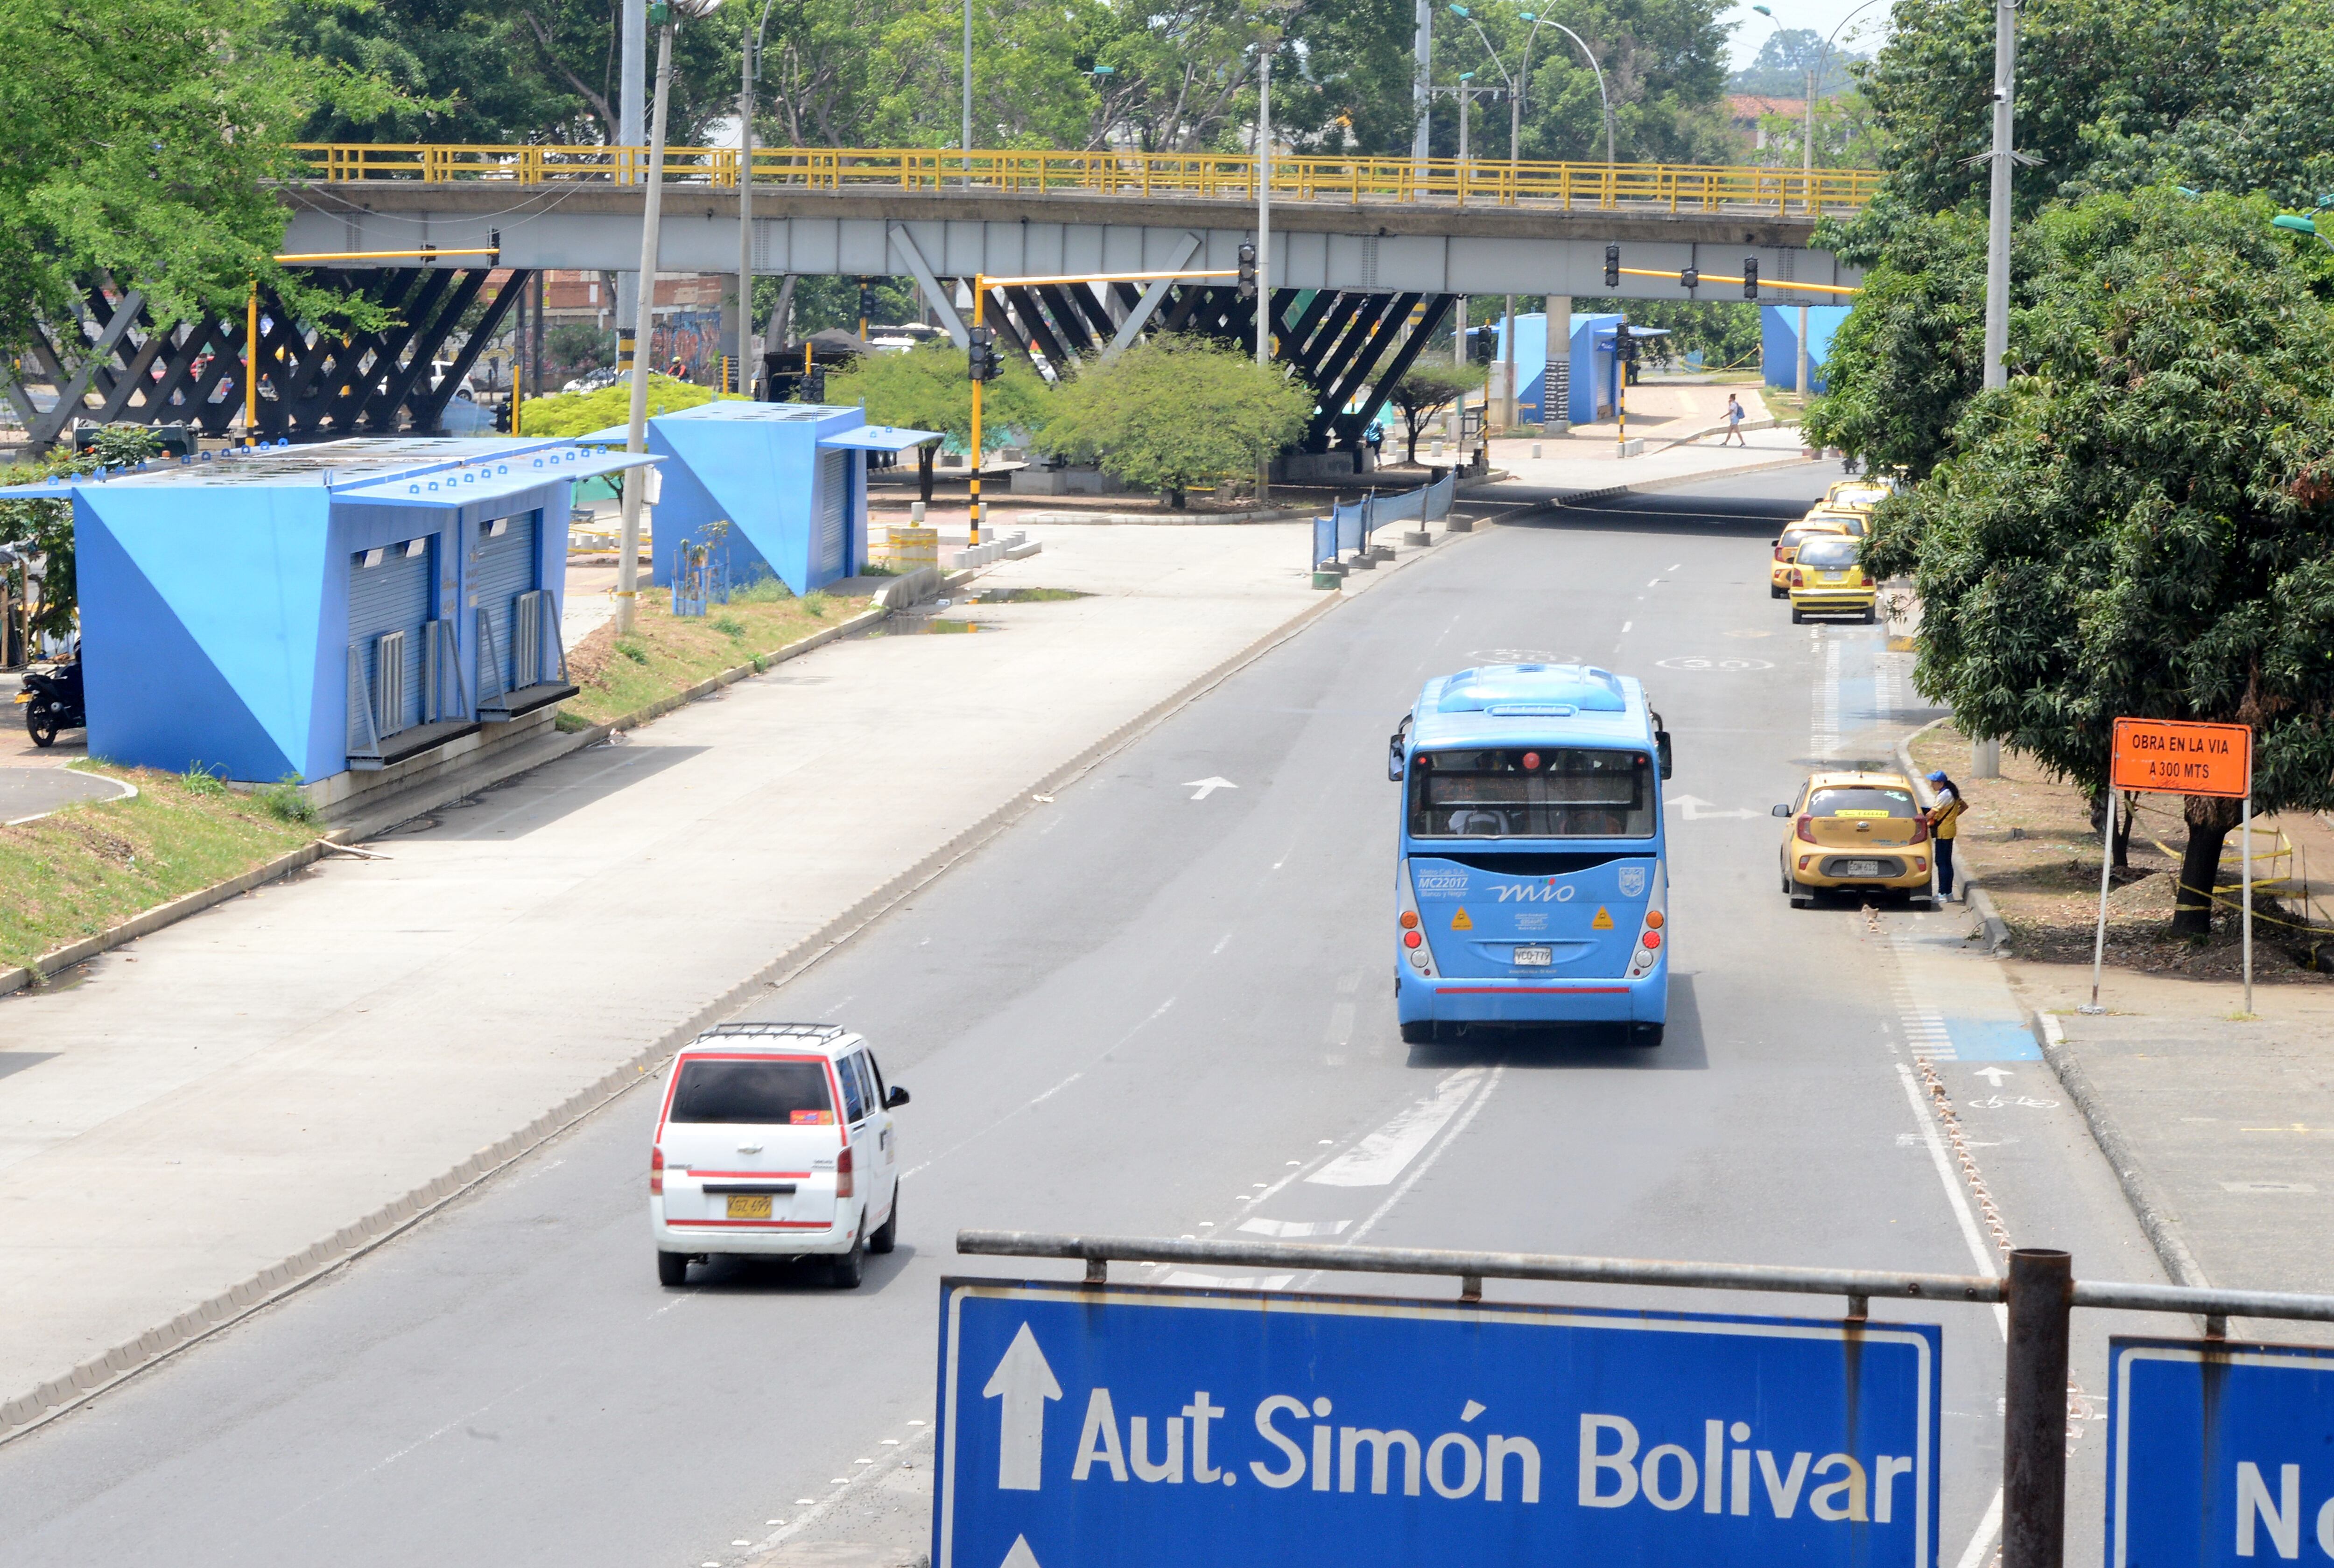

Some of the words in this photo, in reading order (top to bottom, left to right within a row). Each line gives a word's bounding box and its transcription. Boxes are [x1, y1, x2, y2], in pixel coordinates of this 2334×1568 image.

[2132, 735, 2165, 751] OBRA
[2169, 736, 2185, 752] EN
[2189, 737, 2204, 753] LA
[2208, 739, 2229, 754] VIA
[2149, 762, 2156, 775] A
[2159, 762, 2180, 777] 300
[2184, 763, 2209, 778] MTS
[1419, 877, 1468, 888] MC22017
[1071, 1387, 1237, 1487] Aut.
[1249, 1395, 1541, 1503] Simón
[1578, 1413, 1912, 1524] Bolivar
